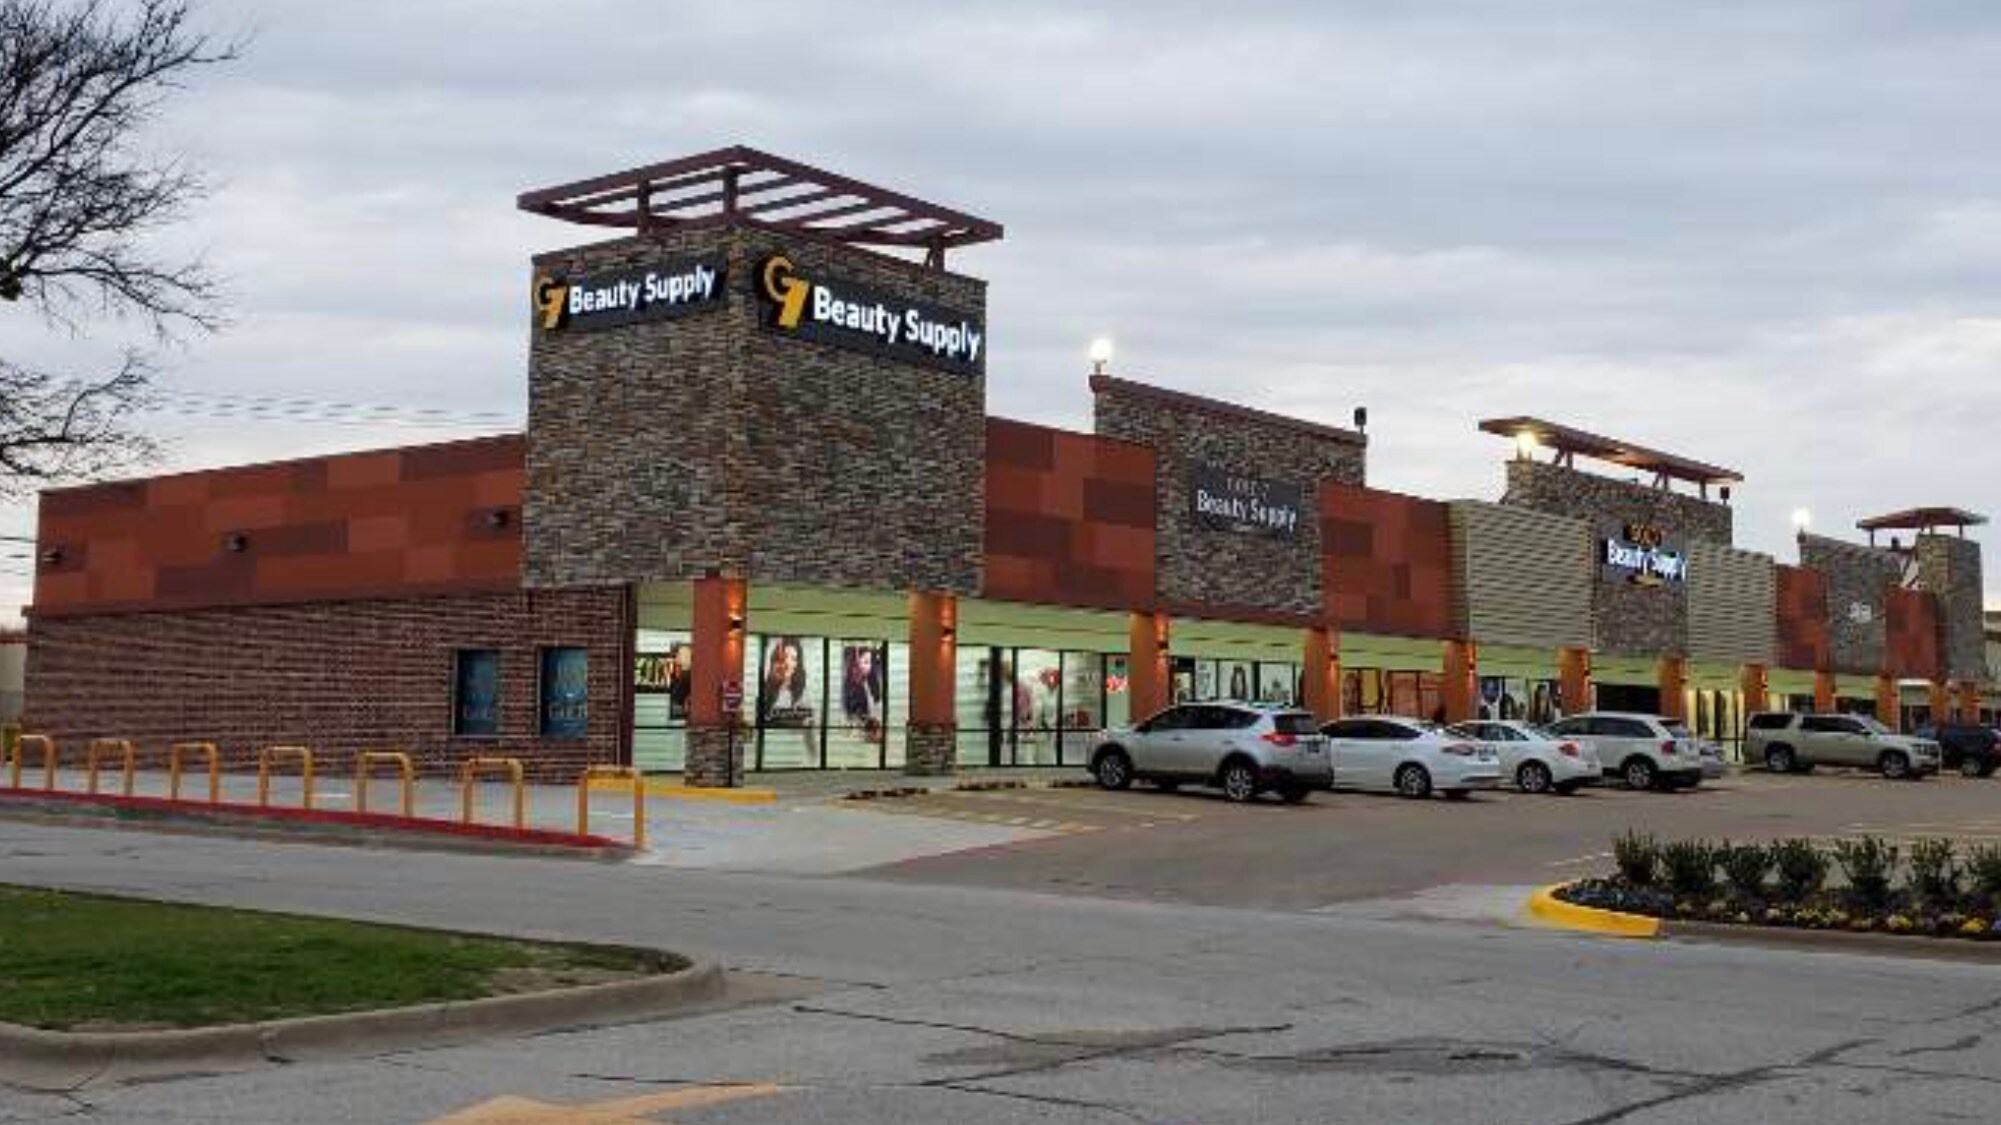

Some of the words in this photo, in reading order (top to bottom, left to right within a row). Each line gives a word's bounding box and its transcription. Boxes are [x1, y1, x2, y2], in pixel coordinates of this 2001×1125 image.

[569, 284, 641, 314] Beauty
[645, 265, 715, 303] Supply
[764, 256, 809, 328] G7
[813, 285, 901, 343] Beauty
[905, 308, 980, 361] Supply
